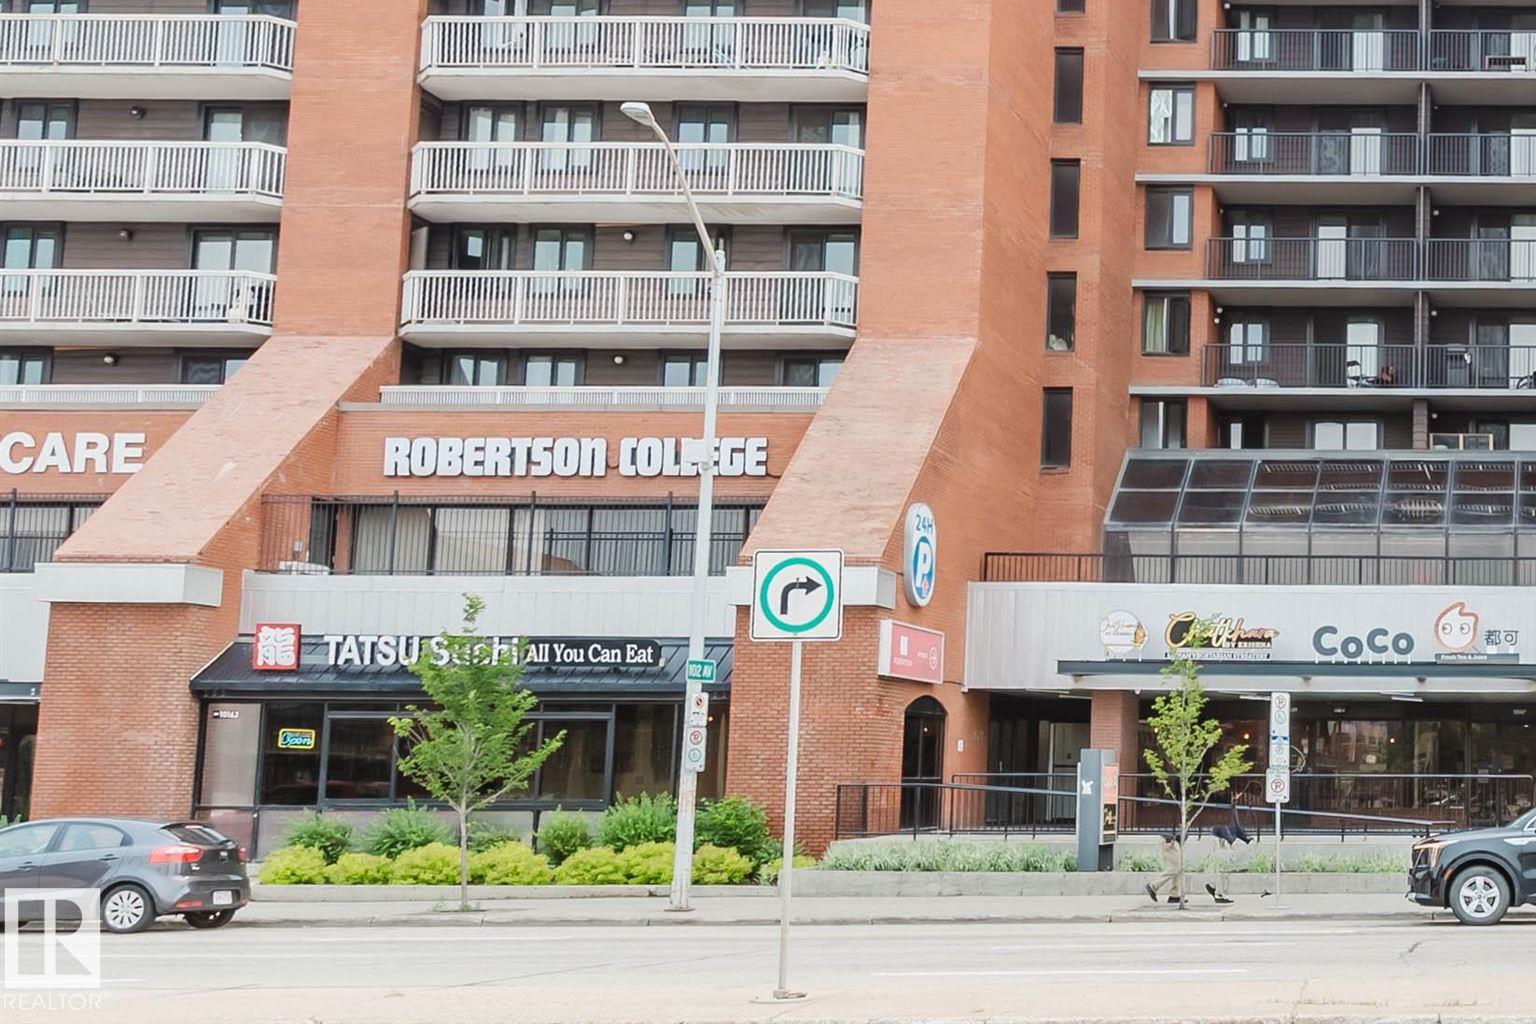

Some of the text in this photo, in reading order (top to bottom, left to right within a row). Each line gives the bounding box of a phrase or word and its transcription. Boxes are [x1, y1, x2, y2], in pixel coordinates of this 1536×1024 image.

[0, 432, 146, 474] CARE
[384, 437, 606, 476] ROBERTSON
[916, 514, 933, 536] 24H
[323, 635, 421, 666] TATSU
[525, 643, 549, 663] All
[553, 643, 585, 663] You
[588, 644, 621, 664] Can
[625, 644, 654, 663] Eat
[1312, 625, 1415, 660] CoCo
[1484, 630, 1520, 647] 都可
